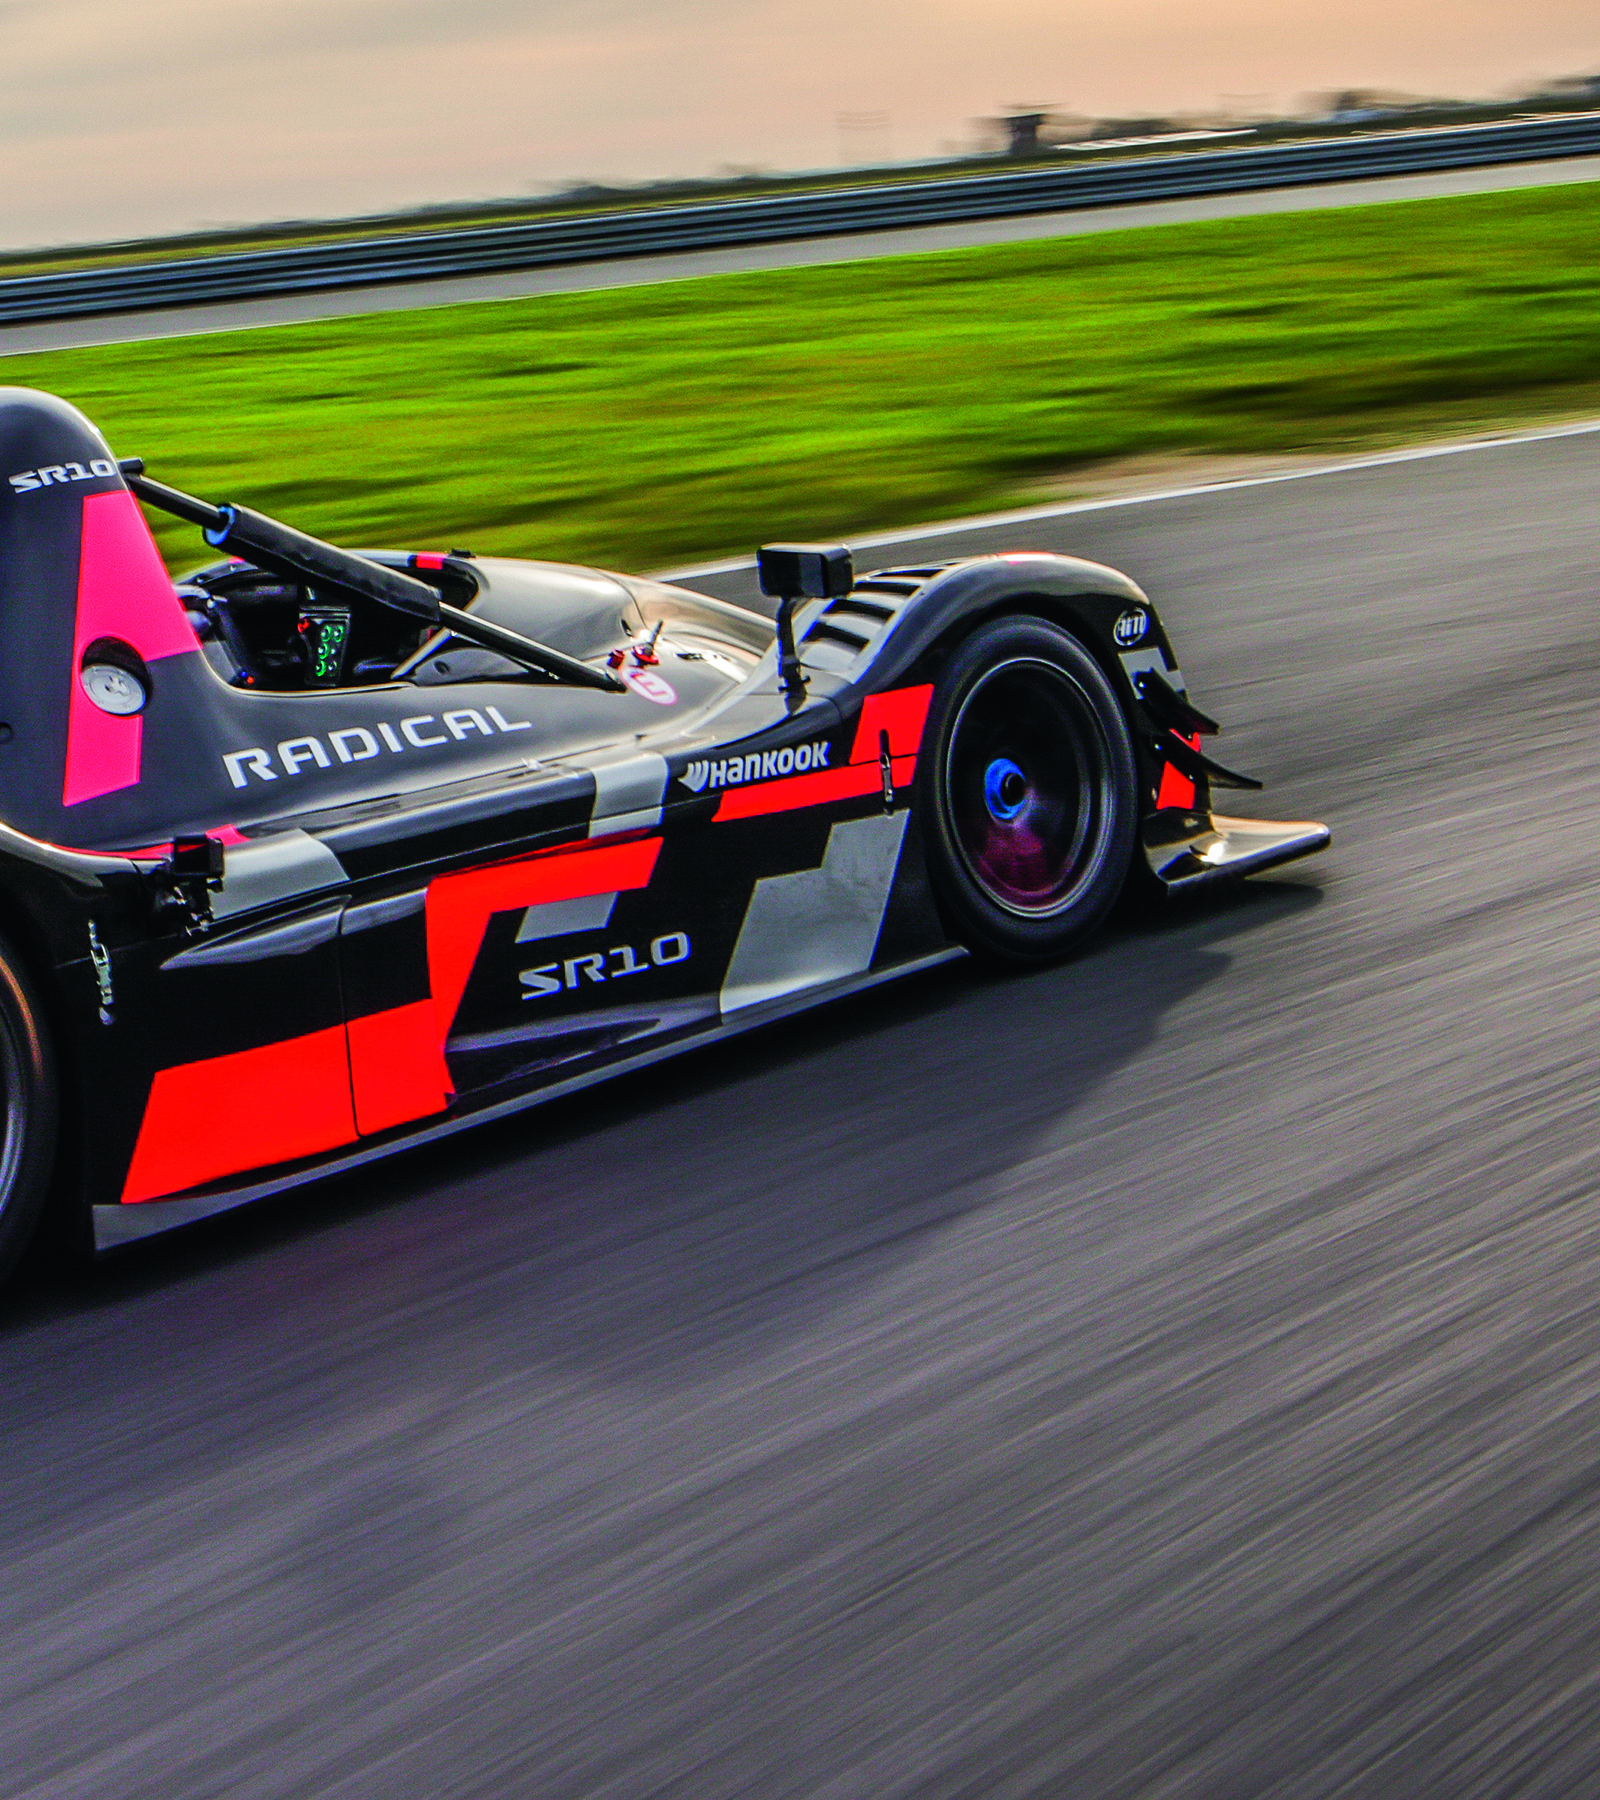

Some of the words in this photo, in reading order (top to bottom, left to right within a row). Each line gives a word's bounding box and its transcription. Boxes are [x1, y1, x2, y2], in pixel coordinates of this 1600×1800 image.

[8, 459, 117, 494] SR10
[222, 705, 532, 788] RADICAL
[518, 931, 691, 1001] SR10
